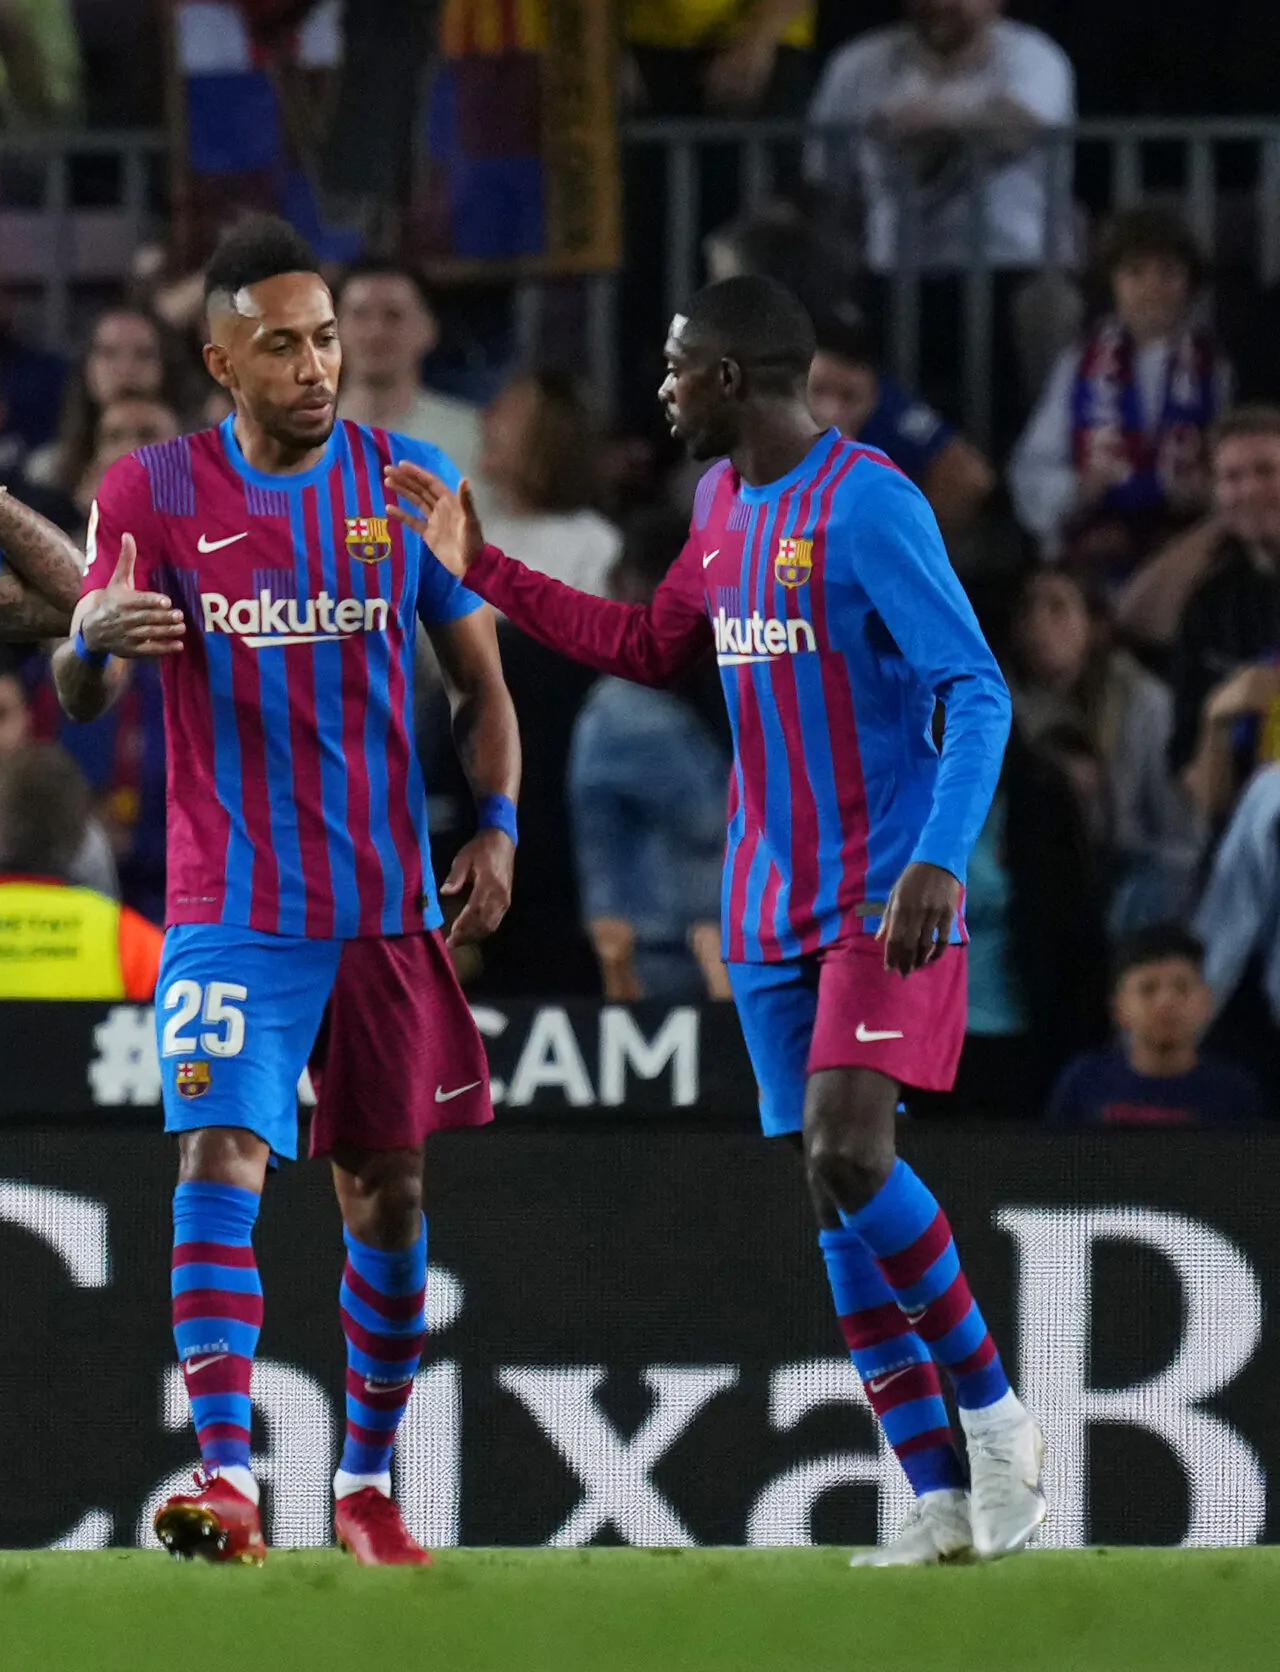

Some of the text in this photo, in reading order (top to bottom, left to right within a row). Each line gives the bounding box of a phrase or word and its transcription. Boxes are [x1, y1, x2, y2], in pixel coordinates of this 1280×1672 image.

[200, 588, 390, 634] Rakuten
[712, 607, 817, 654] kuten
[162, 979, 248, 1058] 25
